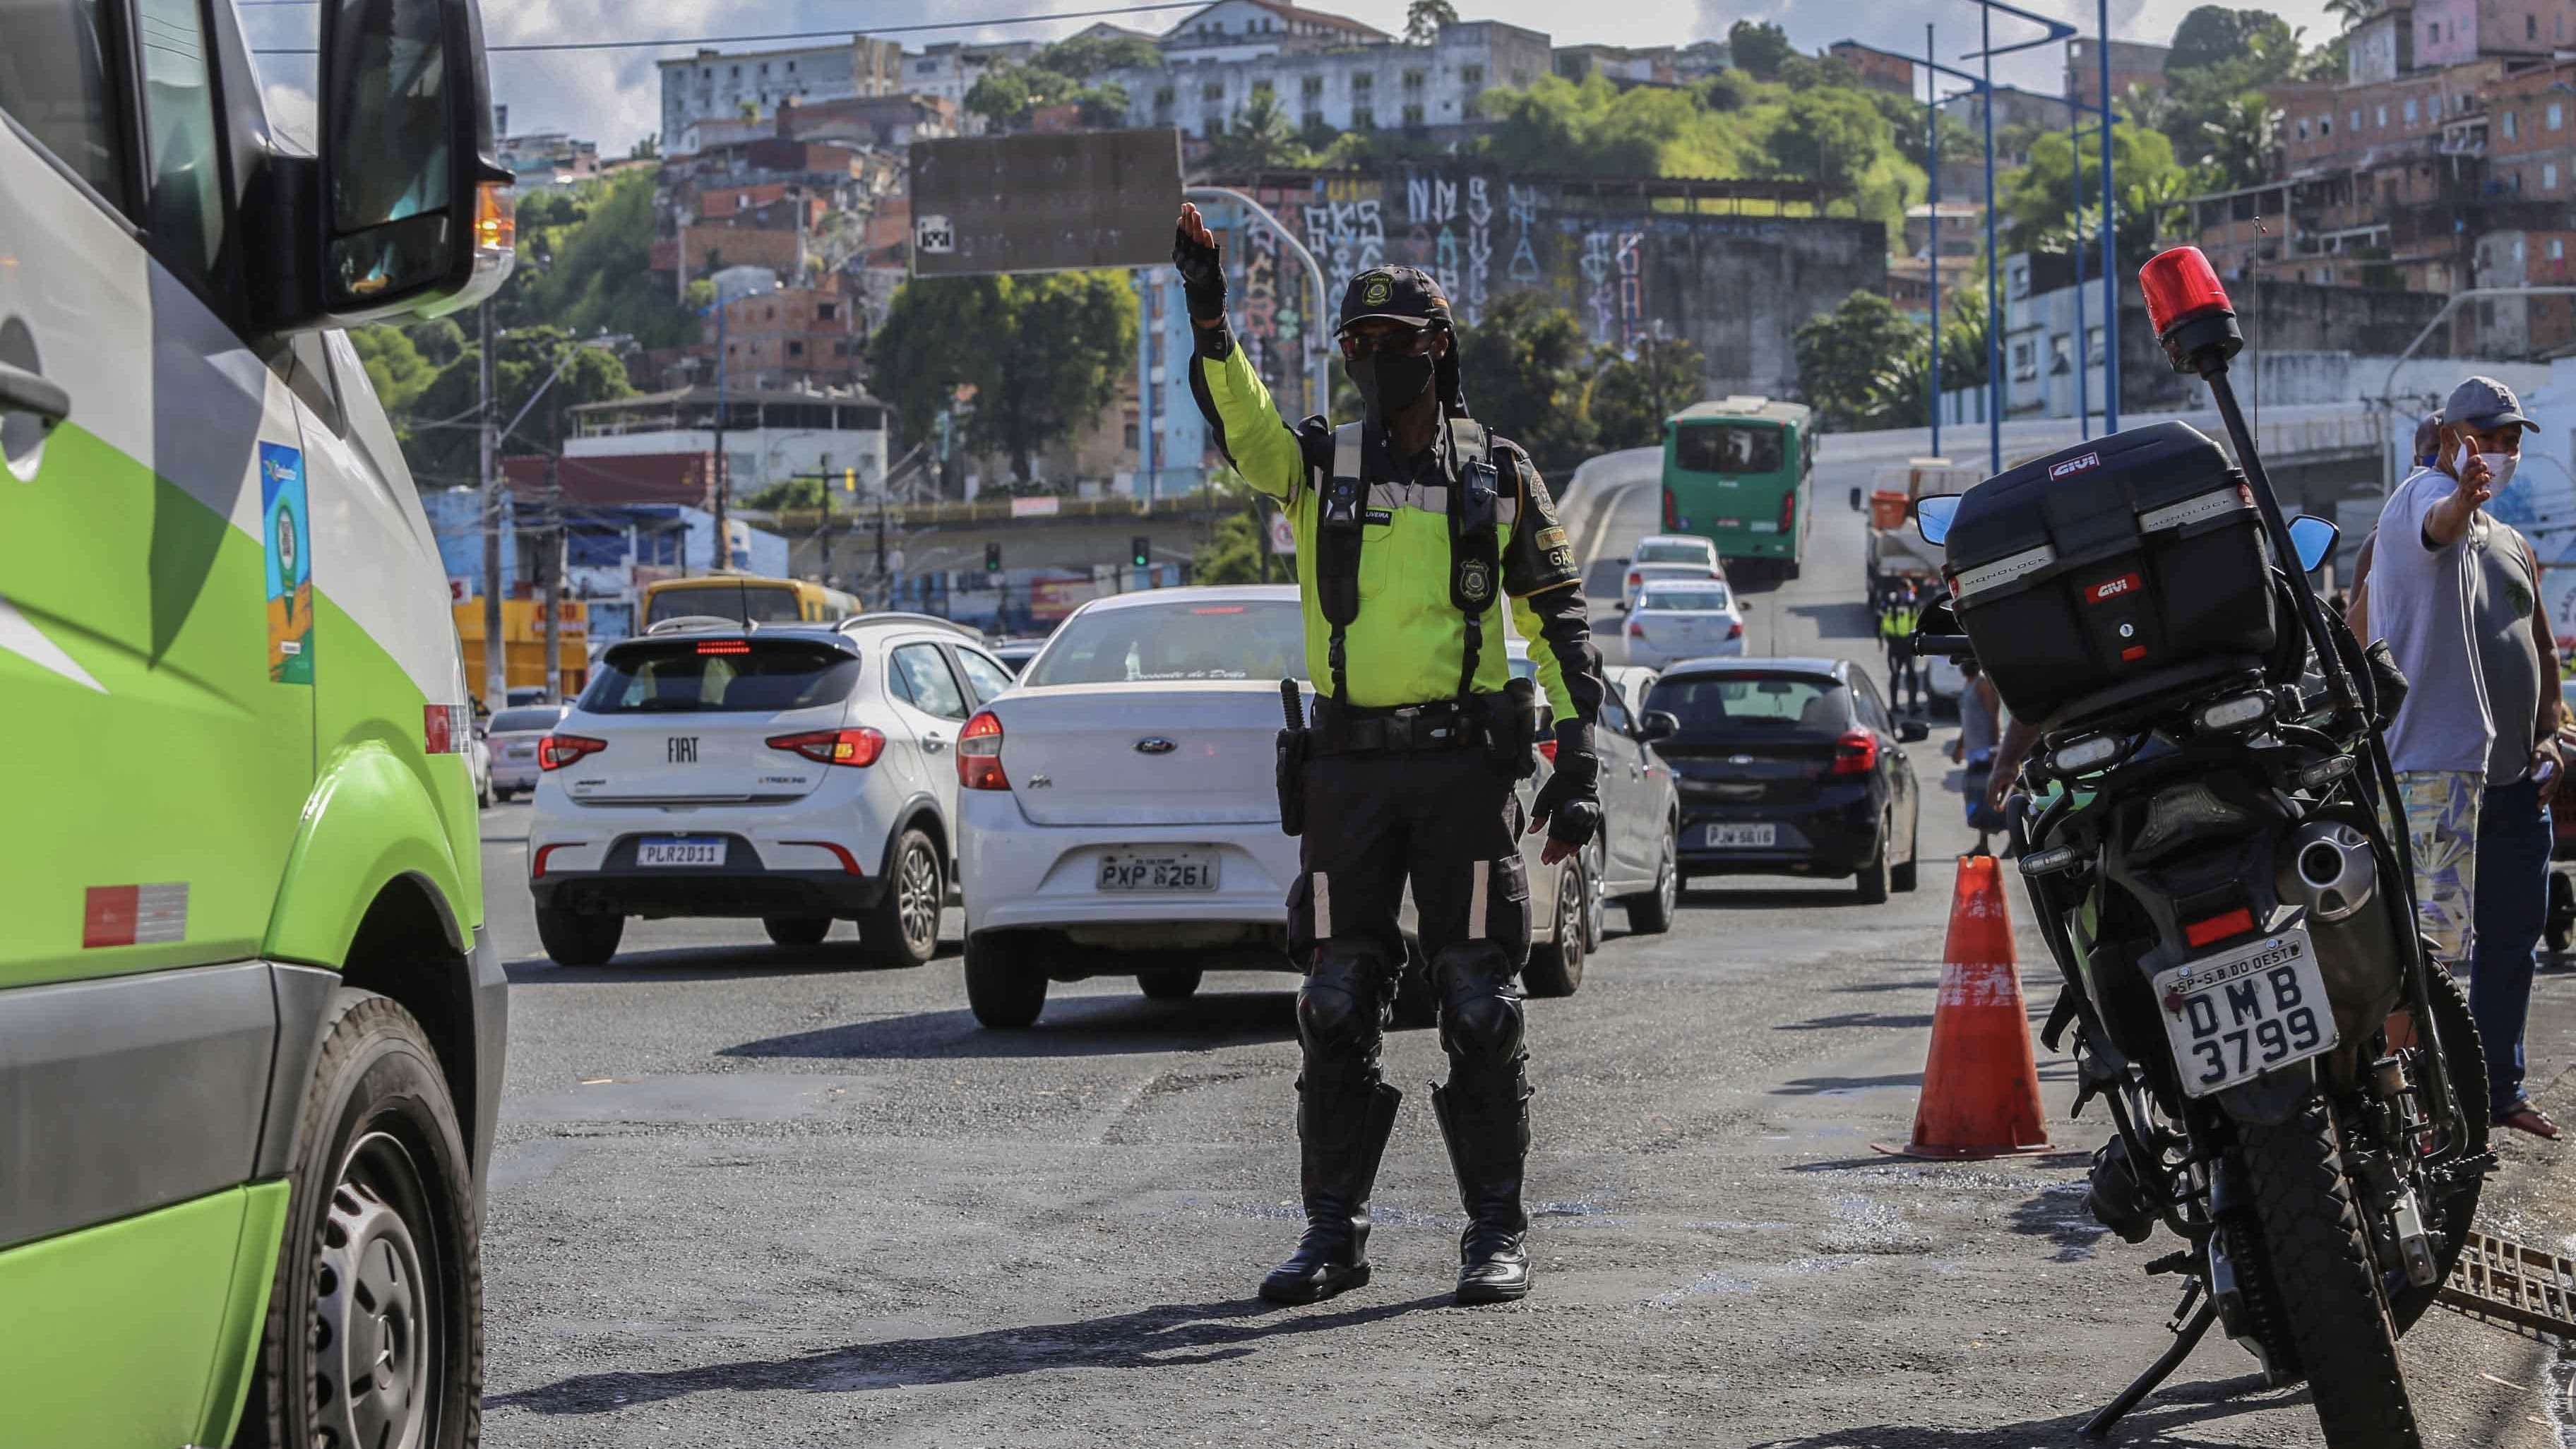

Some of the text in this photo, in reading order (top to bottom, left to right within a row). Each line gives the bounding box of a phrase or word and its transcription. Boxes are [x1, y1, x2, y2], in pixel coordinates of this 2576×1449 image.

[2053, 455, 2096, 476] GIVI
[1964, 554, 2046, 585] MONOLOCK
[2097, 578, 2128, 597] GIVI
[667, 737, 699, 763] FIAT
[1102, 865, 1146, 888] PXP
[2185, 965, 2302, 1039] DMB
[2192, 1006, 2320, 1084] 3799
